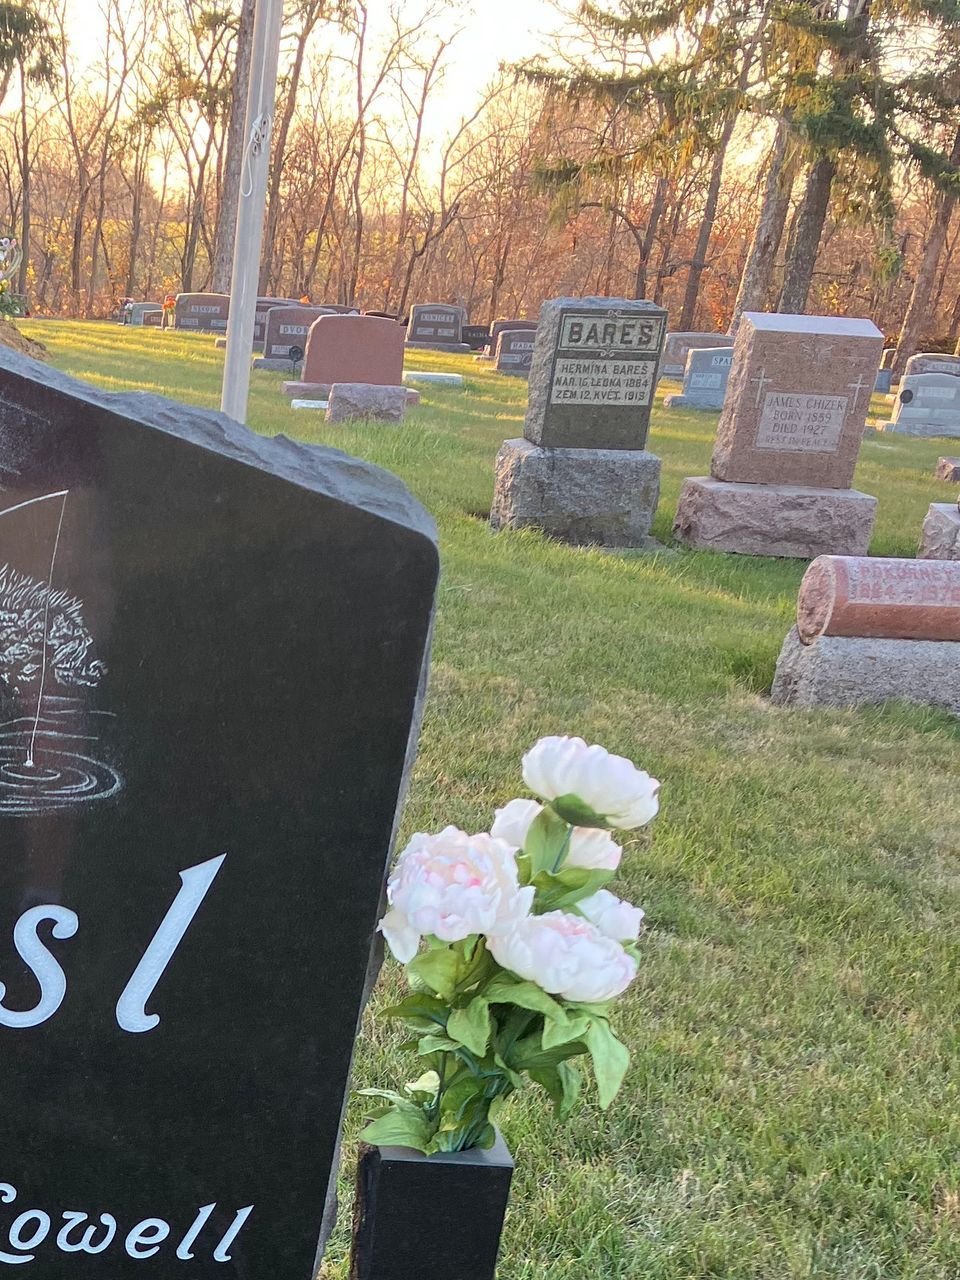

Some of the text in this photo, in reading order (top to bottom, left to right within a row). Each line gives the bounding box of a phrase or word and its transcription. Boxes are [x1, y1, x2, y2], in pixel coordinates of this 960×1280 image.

[767, 396, 801, 408] JAMES
[773, 409, 800, 421] BORN
[772, 422, 828, 436] DIED 1927
